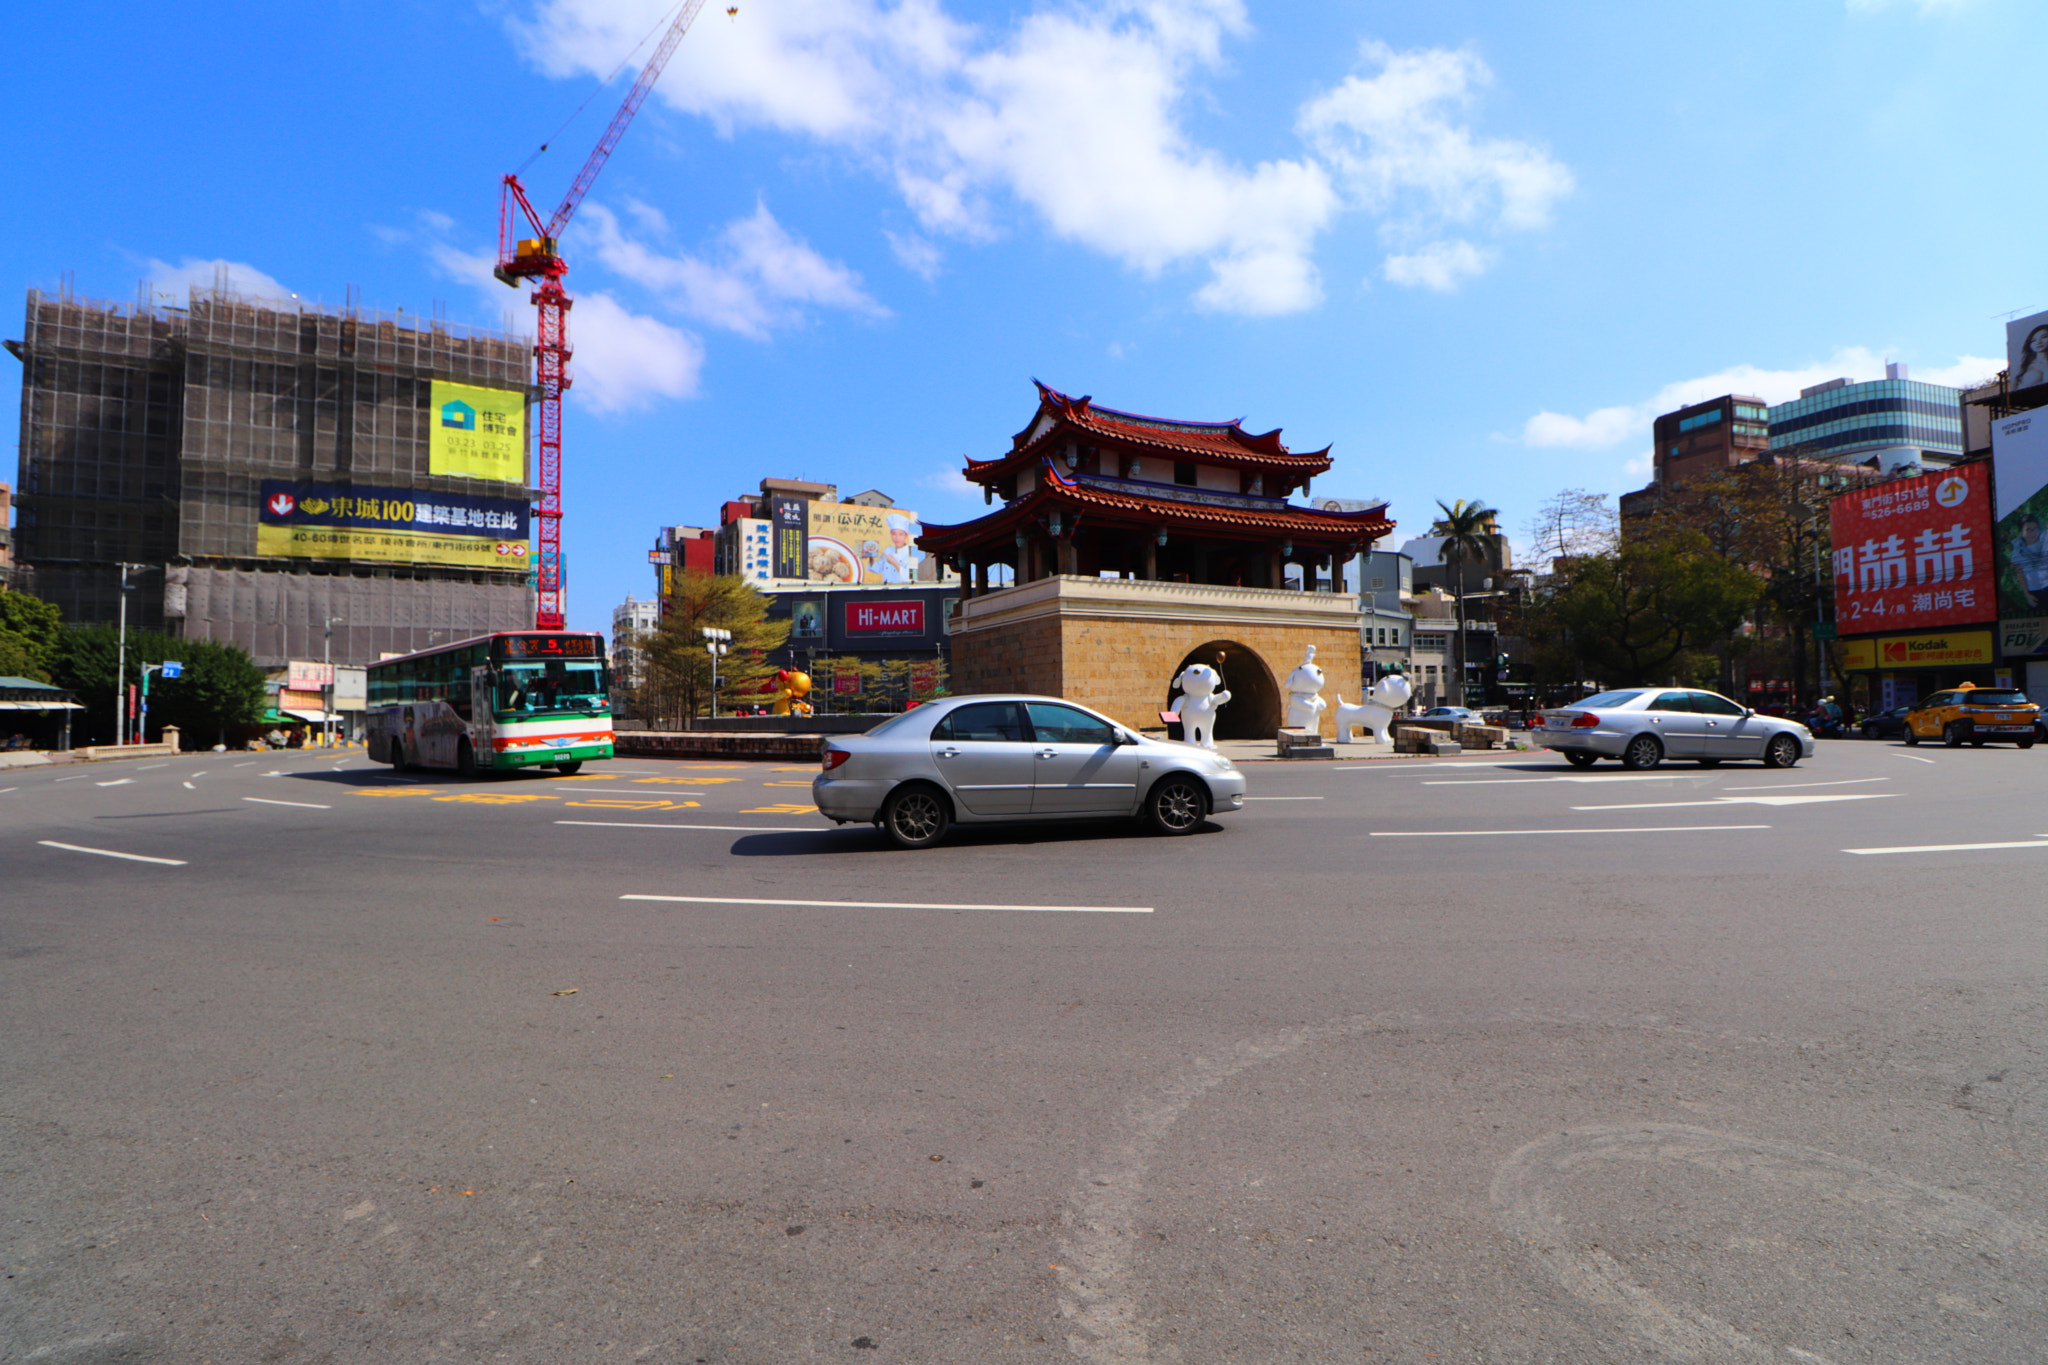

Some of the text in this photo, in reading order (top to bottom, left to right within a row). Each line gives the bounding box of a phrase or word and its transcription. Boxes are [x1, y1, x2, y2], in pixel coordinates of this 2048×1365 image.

[482, 411, 507, 424] 住宅
[1912, 589, 1975, 612] 潮尚宅
[858, 608, 917, 626] Hi-MART
[547, 639, 558, 649] 5
[1908, 640, 1949, 651] Kodak
